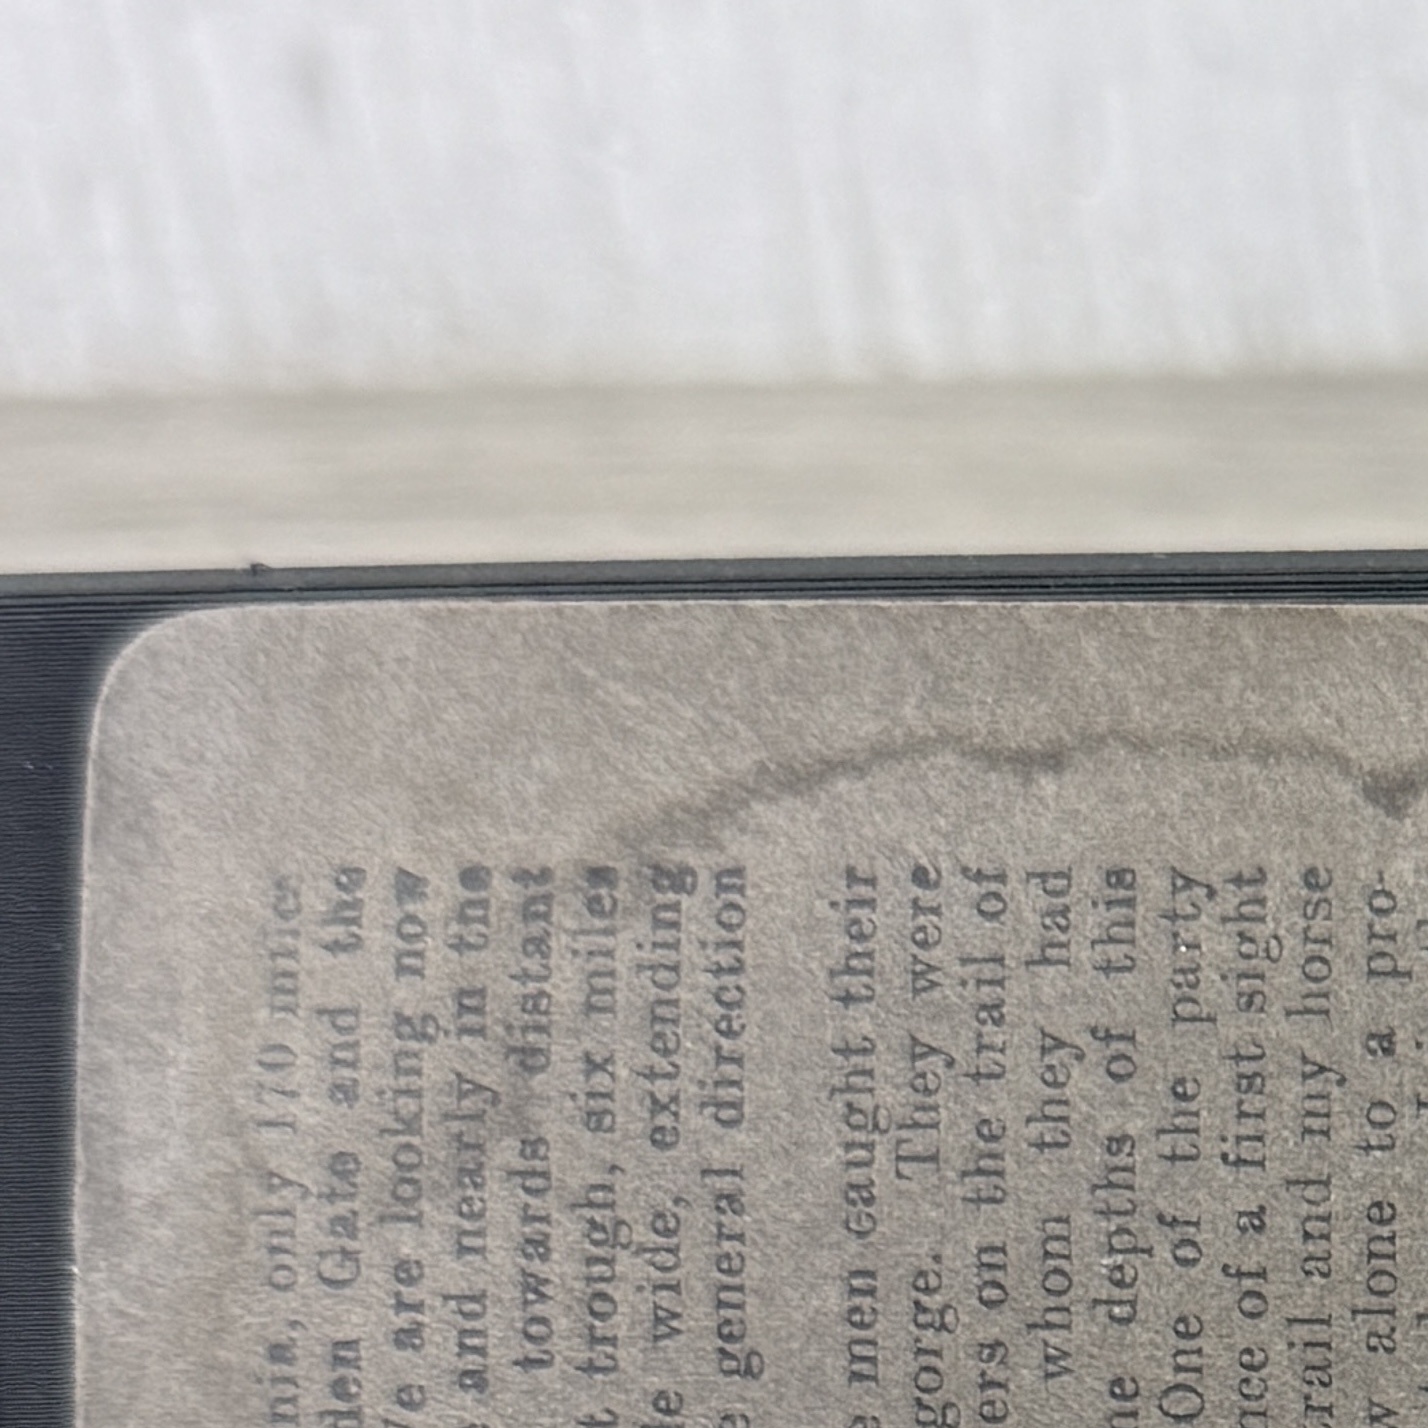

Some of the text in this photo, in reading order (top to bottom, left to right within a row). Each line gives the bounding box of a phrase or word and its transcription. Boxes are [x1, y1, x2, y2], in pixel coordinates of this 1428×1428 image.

[827, 864, 878, 1009] their
[909, 862, 943, 997] were
[1159, 865, 1219, 1027] party
[1365, 868, 1414, 982] pro-
[697, 866, 747, 1129] direction
[1362, 1025, 1397, 1059] a
[377, 1011, 441, 1228] looking
[828, 1035, 890, 1240] caught
[893, 1032, 957, 1181] They
[1153, 1075, 1201, 1166] the
[1352, 1098, 1399, 1156] to
[392, 1259, 426, 1352] are
[699, 1166, 764, 1381] general
[1154, 1210, 1204, 1269] of
[1349, 1199, 1399, 1356] alone
[840, 1267, 880, 1386] men
[1156, 1313, 1206, 1425] One
